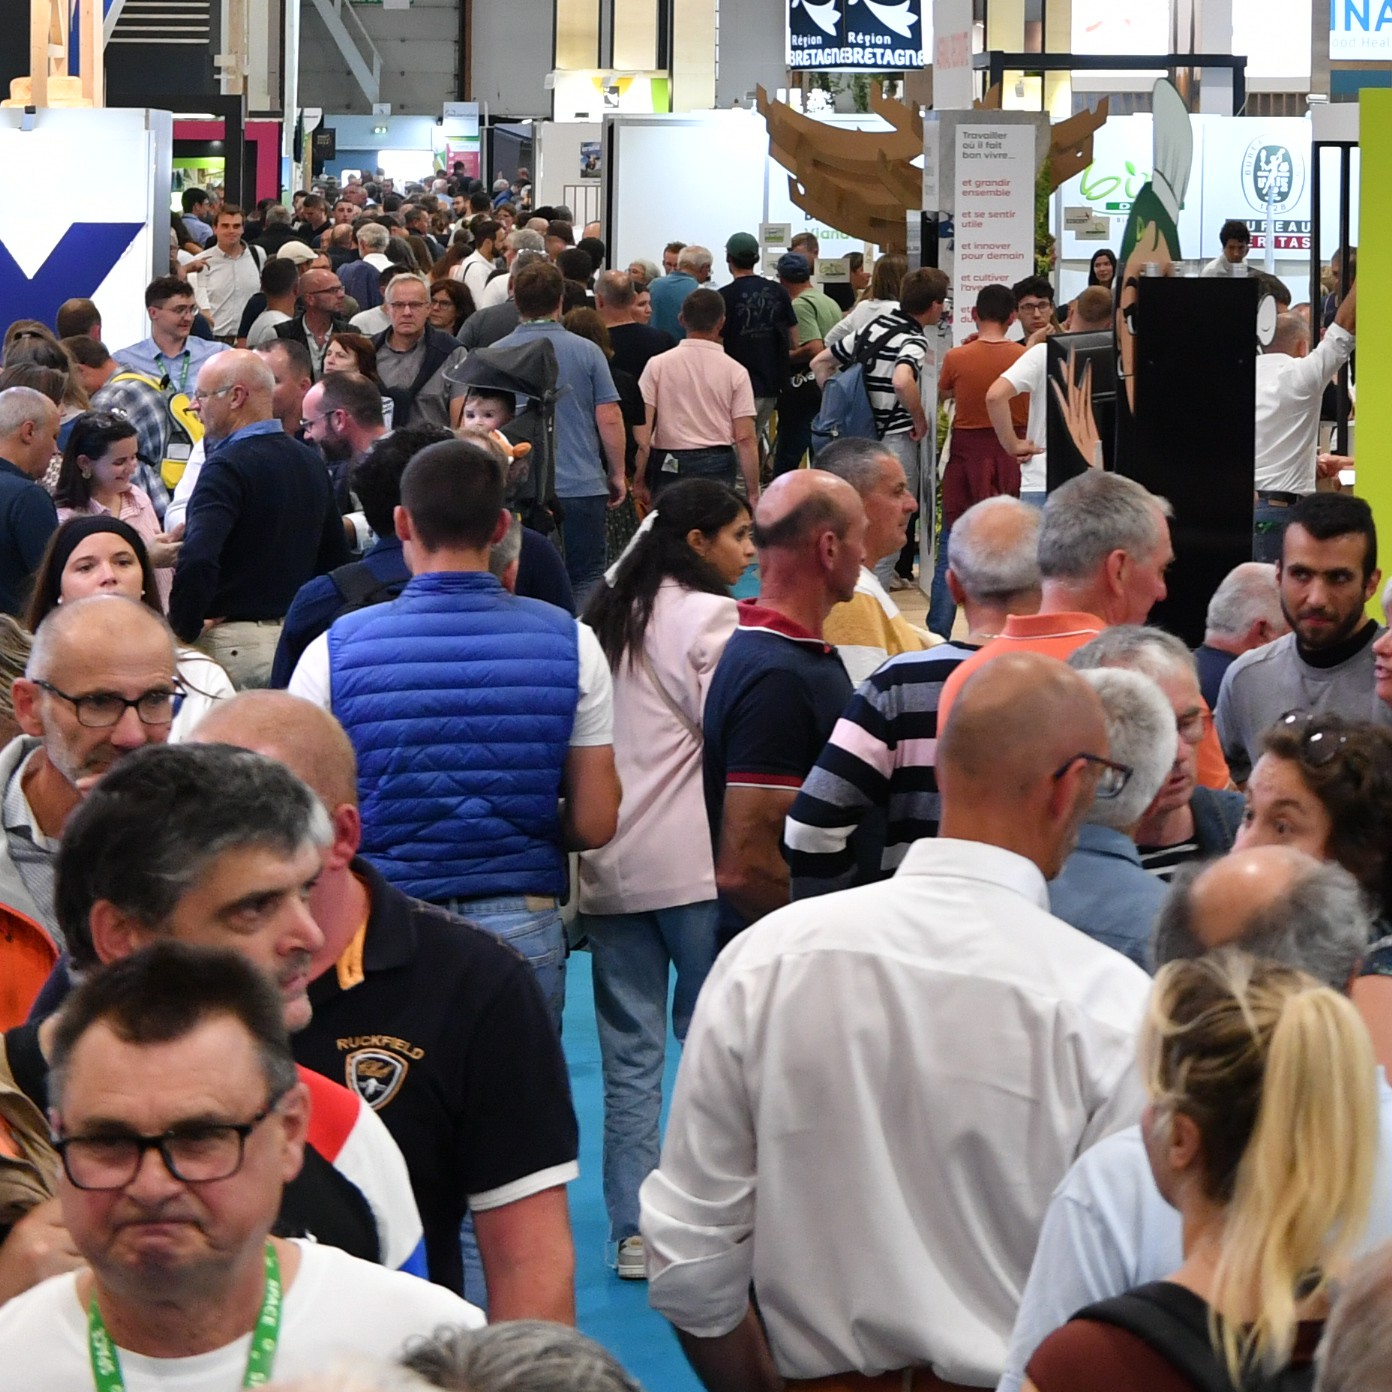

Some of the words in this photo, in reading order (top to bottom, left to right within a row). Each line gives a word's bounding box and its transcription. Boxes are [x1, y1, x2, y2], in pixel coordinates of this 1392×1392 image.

[792, 34, 823, 47] Région
[848, 32, 892, 46] Région
[962, 131, 1008, 140] Travailler
[985, 141, 1003, 149] fait
[962, 151, 982, 159] bon
[961, 179, 972, 187] et
[974, 178, 1010, 189] grandir
[961, 188, 1011, 197] ensemble
[961, 210, 972, 219] et
[974, 211, 985, 219] se
[988, 210, 1016, 219] sentir
[961, 220, 983, 228] utile
[961, 242, 971, 250] et
[974, 242, 1011, 250] innover
[961, 253, 984, 261] pour
[986, 251, 1025, 260] demain
[961, 274, 971, 282] et
[973, 273, 1009, 282] cultiver
[336, 1035, 425, 1060] RUCKFIELD
